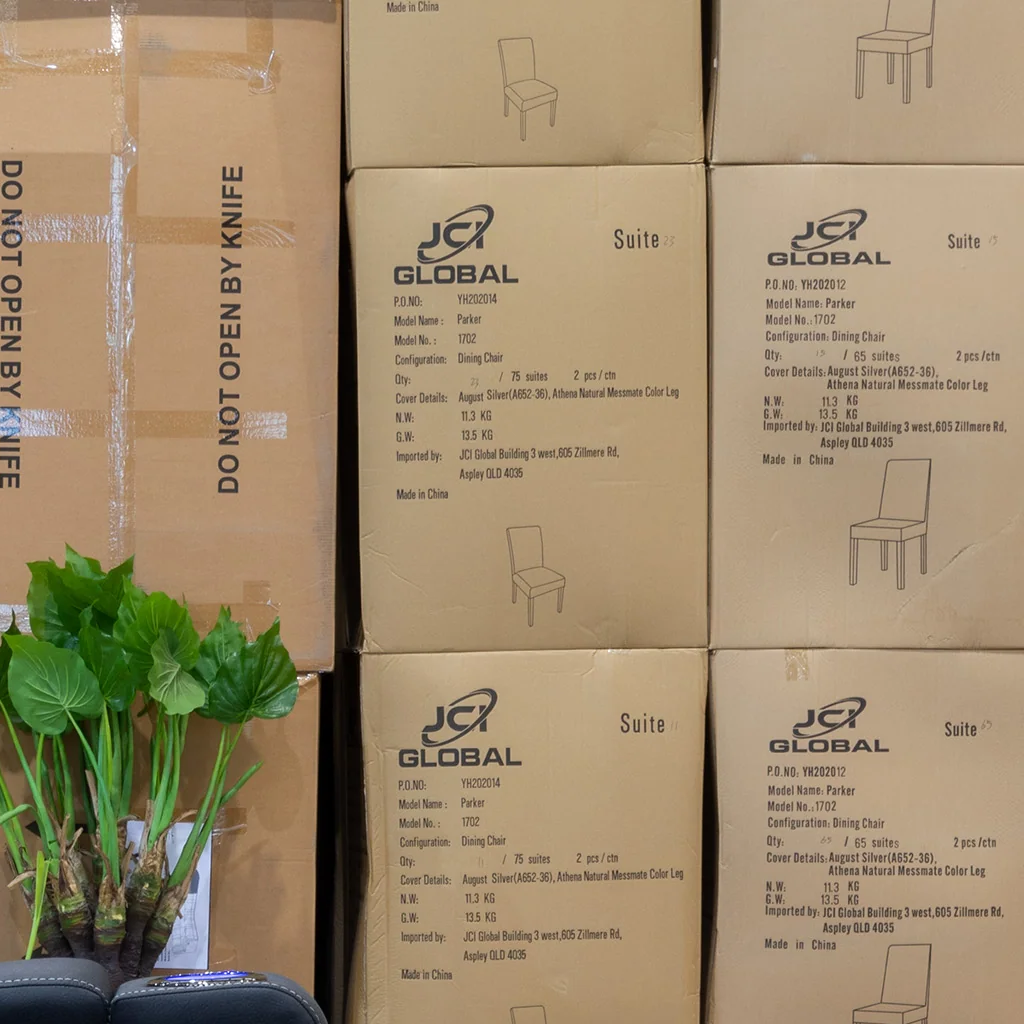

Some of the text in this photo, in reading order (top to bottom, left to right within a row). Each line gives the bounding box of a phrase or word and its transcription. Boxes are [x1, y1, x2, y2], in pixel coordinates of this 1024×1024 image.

[387, 1, 440, 12] Made in China
[614, 228, 660, 250] Suite
[948, 234, 981, 250] Suite
[767, 251, 892, 266] GLOBAL
[394, 264, 519, 285] GLOBAL
[765, 278, 847, 291] P.O.NO: YH202012
[394, 294, 498, 308] P.O.NO: YH202014
[766, 298, 856, 310] Model Name: Parker
[0, 160, 23, 490] DO NOT OPEN BY KNIFE
[458, 314, 482, 326] Parker
[218, 165, 244, 494] DO NOT OPEN BY KNIFE
[458, 333, 476, 345] 1702
[766, 330, 886, 344] Configuration: Dining Chair
[395, 352, 504, 368] Configuration: Dining Chair
[458, 386, 680, 405] August Silver(A652-36), Athena Natural Messmate Color Leg
[764, 395, 858, 407] N.W: 11.3 KG
[763, 409, 858, 420] G.W: 13.5 KG
[396, 446, 620, 464] Imported by: JCI Global Building 3 west,605 Zillmere Rd,
[762, 454, 834, 466] Made in China
[459, 467, 524, 482] Aspley QLD 4035
[396, 488, 449, 500] Made in China
[620, 713, 666, 734] Suite
[944, 722, 977, 738] Suite
[769, 739, 890, 754] GLOBAL
[398, 748, 522, 768] GLOBAL
[767, 766, 846, 778] P.O.NO: YH202012
[398, 778, 501, 792] P.O.NO: YH202014
[768, 785, 856, 796] Model Name: Parker
[461, 798, 486, 808] Parker
[462, 816, 480, 828] 1702
[767, 817, 885, 831] Configuration: Dining Chair
[828, 865, 986, 878] Athena Natural Messmate Color Leg
[764, 938, 836, 950] Made in China
[464, 949, 526, 963] Aspley QLD 4035
[401, 968, 452, 980] Made in China
